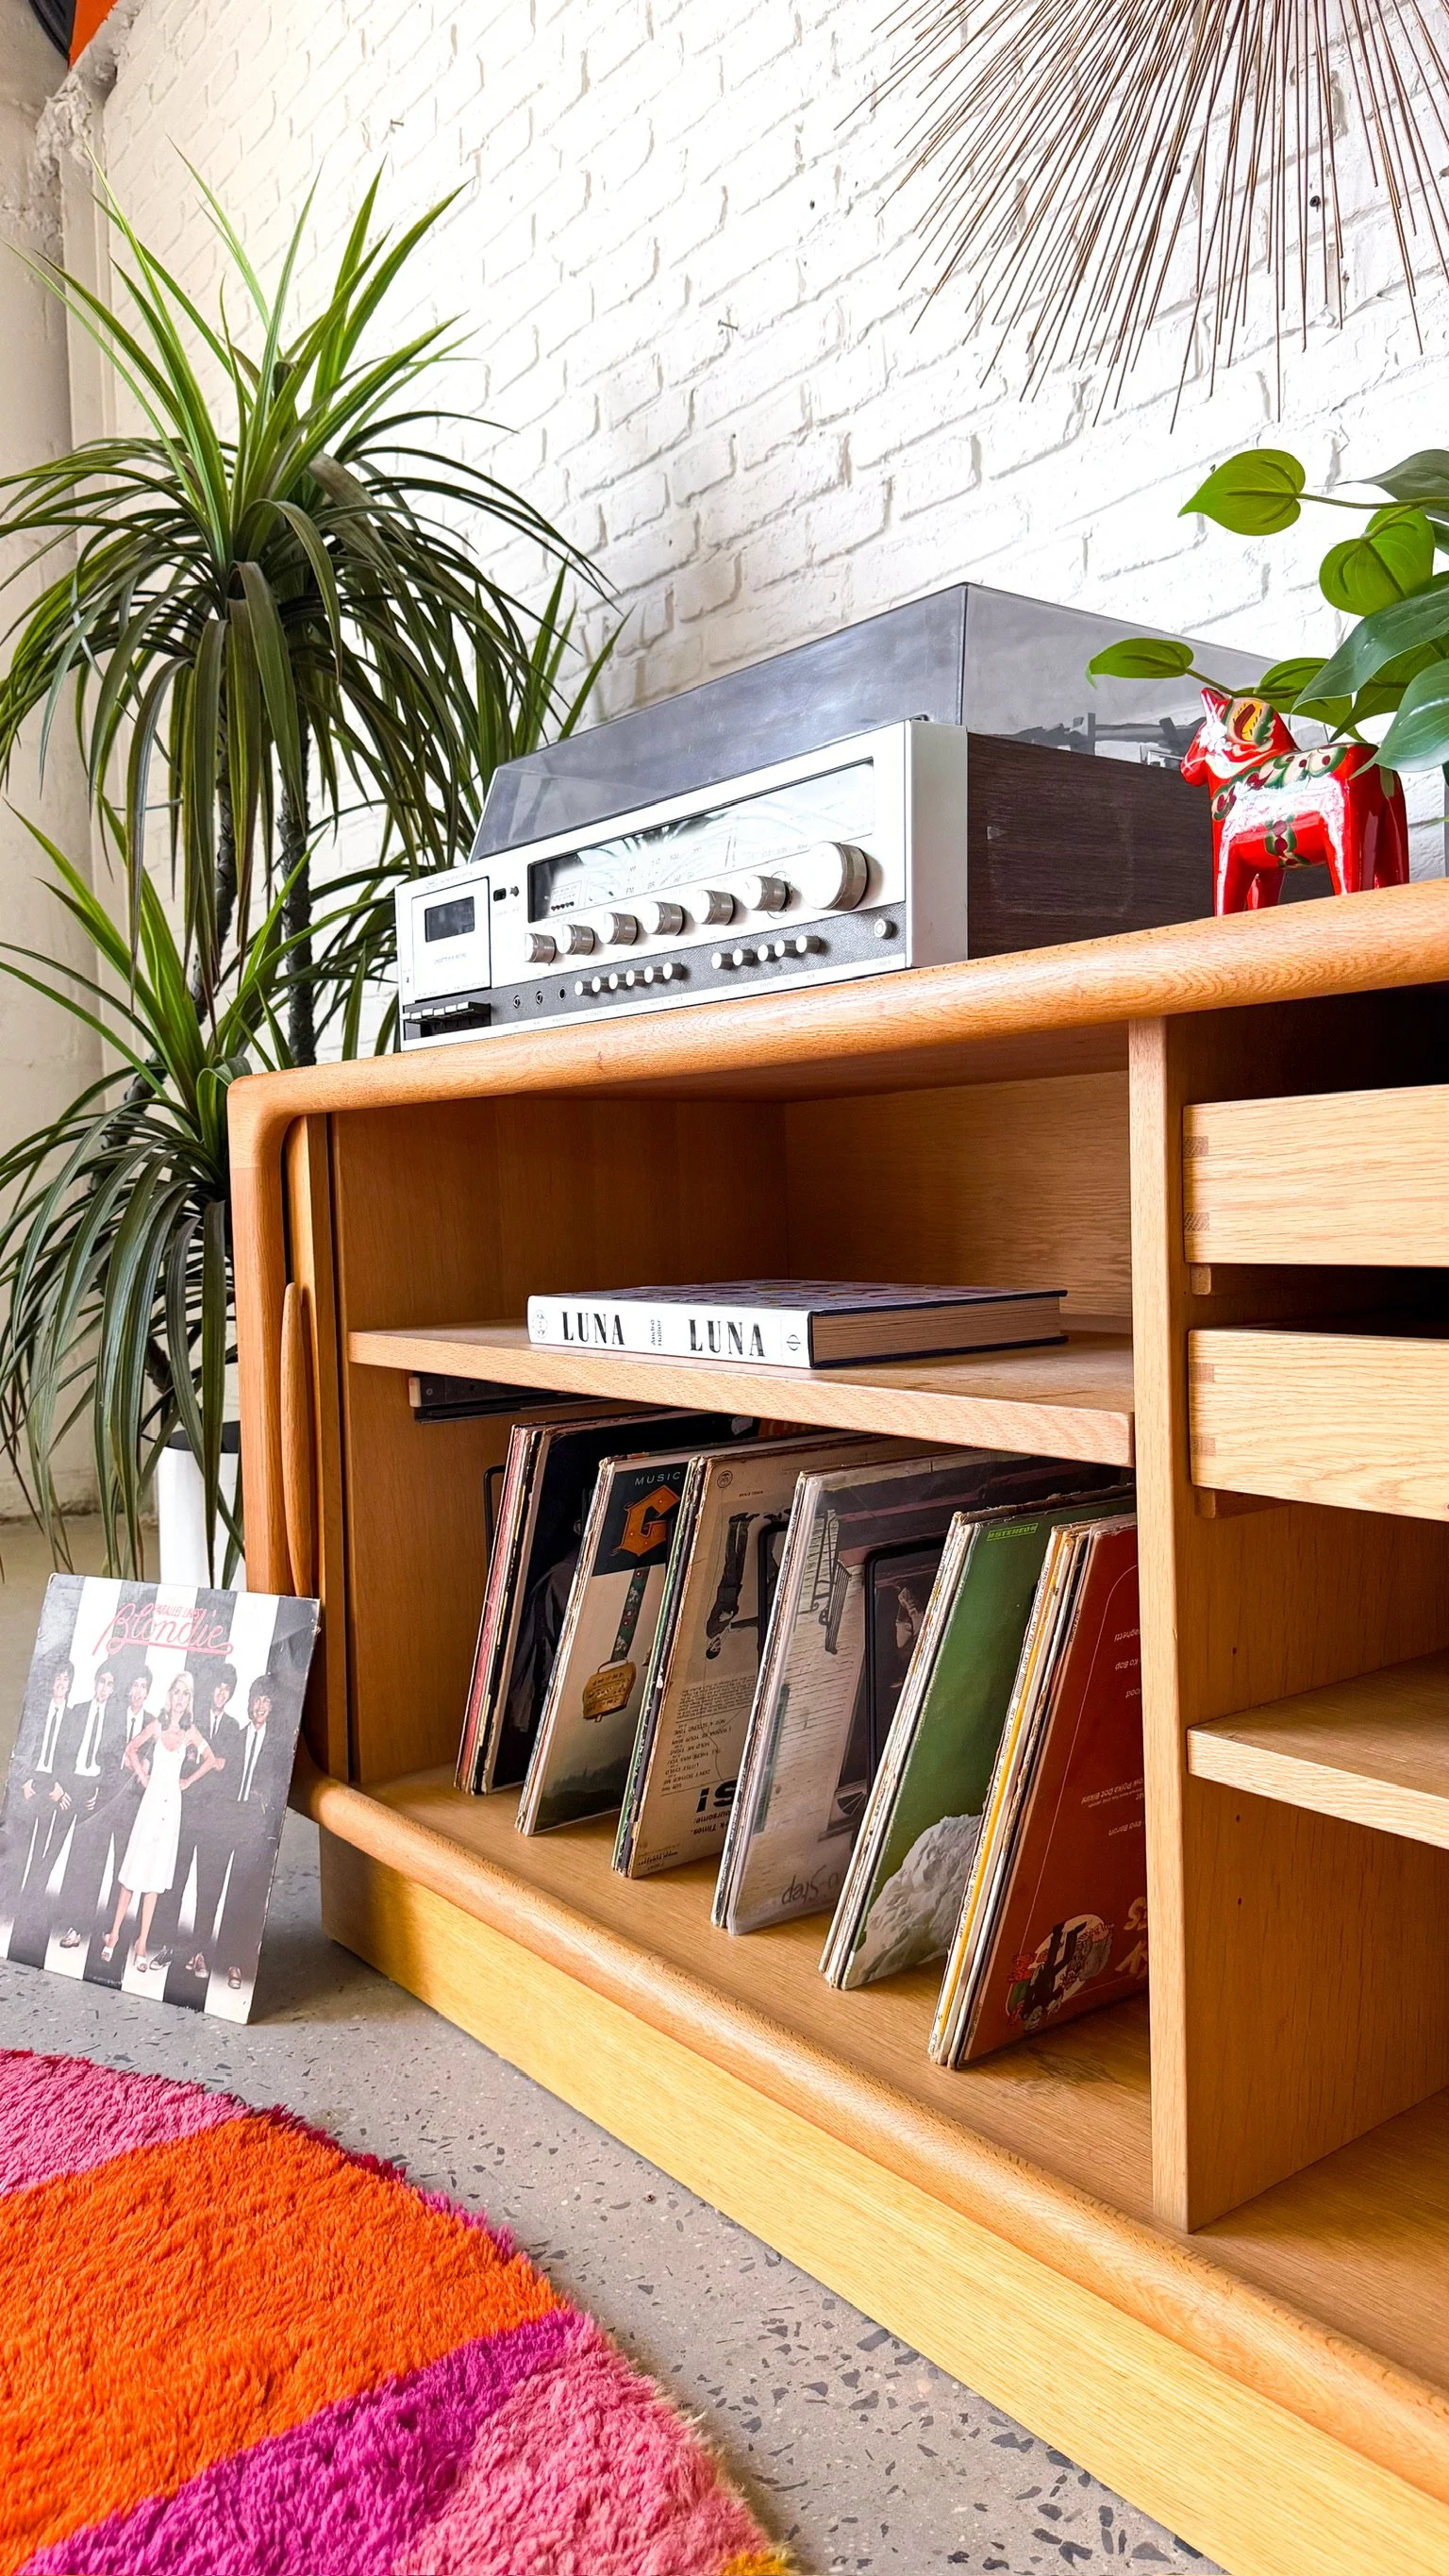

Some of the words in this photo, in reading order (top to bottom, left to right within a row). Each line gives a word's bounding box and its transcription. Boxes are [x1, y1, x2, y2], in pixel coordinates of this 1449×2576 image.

[561, 1311, 625, 1346] LUNA
[689, 1318, 765, 1358] LUNA
[634, 1471, 681, 1486] MUSIC
[92, 1602, 234, 1656] Blondie
[1114, 1629, 1140, 1642] aghetti
[694, 1811, 731, 1824] oursome:
